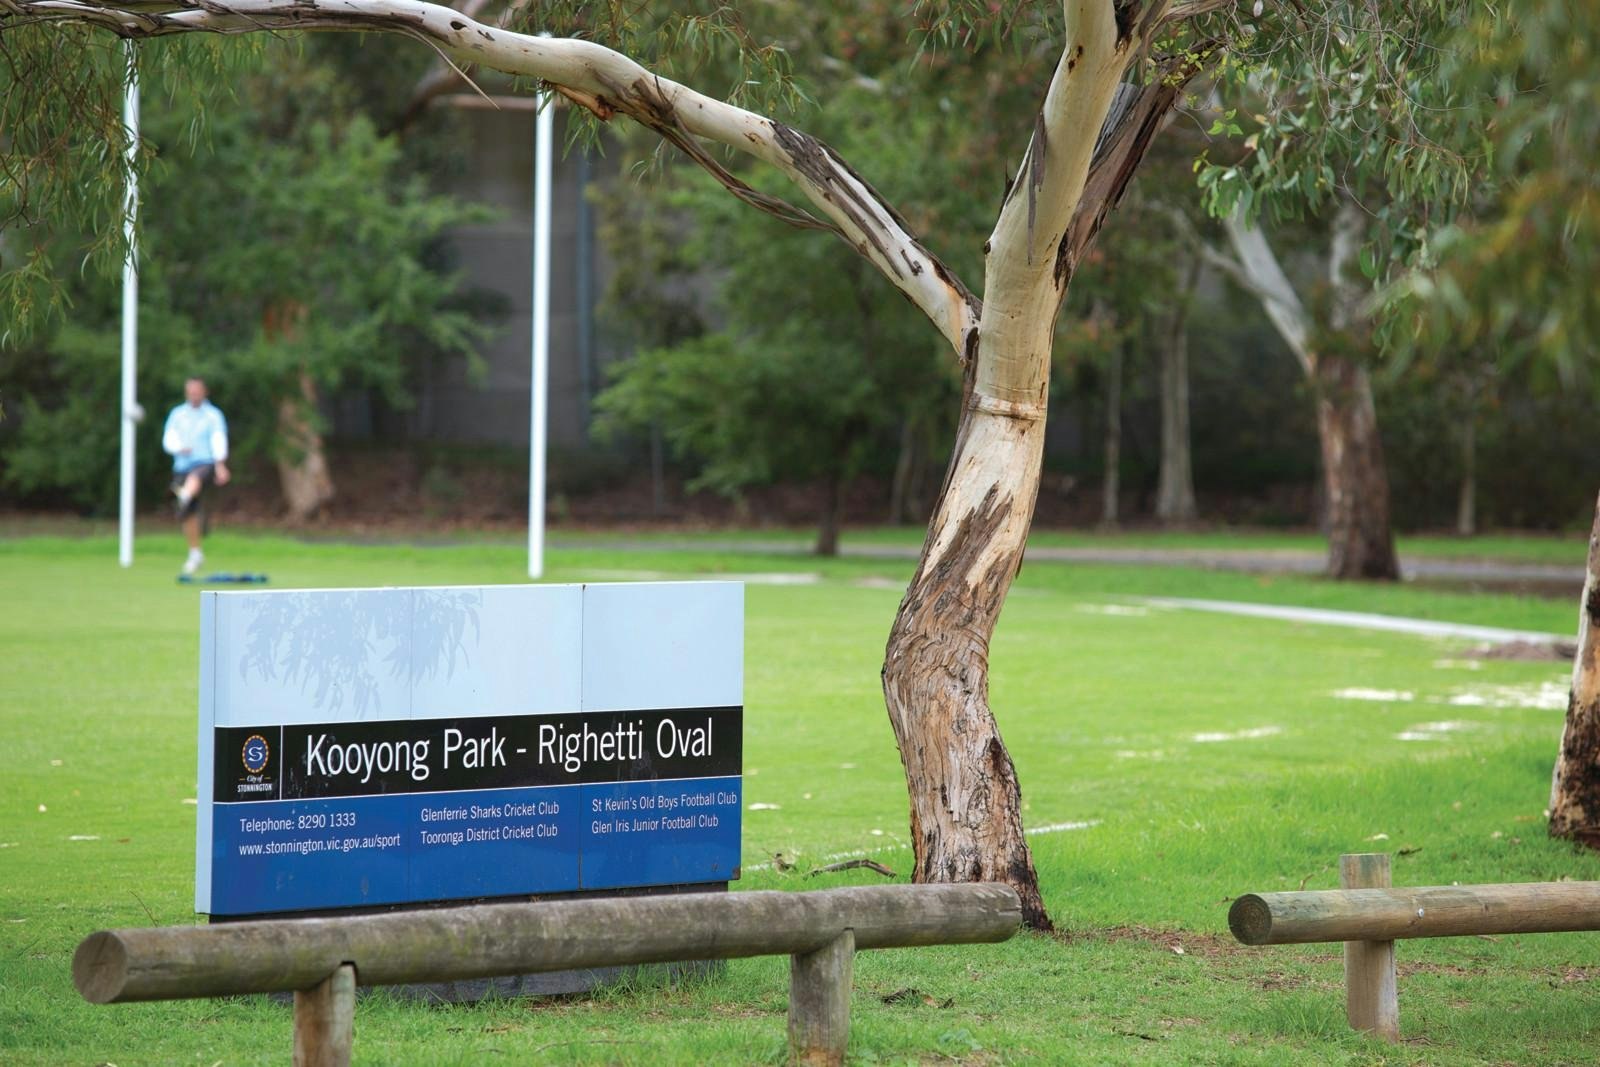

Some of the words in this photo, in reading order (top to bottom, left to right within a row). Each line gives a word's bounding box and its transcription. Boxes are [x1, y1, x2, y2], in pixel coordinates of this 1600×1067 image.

[306, 734, 430, 783] Kooyong
[443, 726, 506, 769] Park
[538, 720, 643, 773] Righetti
[656, 717, 713, 759] Oval
[237, 783, 272, 792] STONNINGTON
[421, 806, 468, 821] Glenferrie
[470, 804, 501, 820] Sharks
[504, 802, 536, 817] Cricket
[538, 801, 560, 815] Club
[592, 798, 602, 812] St
[605, 796, 637, 811] Kevin's
[639, 795, 655, 809] Old
[658, 794, 678, 810] Boys
[681, 792, 715, 807] Football
[718, 791, 737, 805] Club
[240, 817, 295, 833] Telephone:
[298, 813, 326, 829] 8290
[329, 812, 356, 827] 1333
[591, 820, 612, 834] Glen
[615, 818, 629, 833] Iris
[632, 817, 659, 832] Junior
[662, 815, 696, 830] Football
[699, 814, 719, 828] Club
[421, 830, 463, 844] Tooronga
[466, 826, 500, 841] District
[502, 824, 534, 840] Cricket
[537, 823, 558, 837] Club
[239, 834, 400, 855] www.stonnington.vic.gov.au/sport
